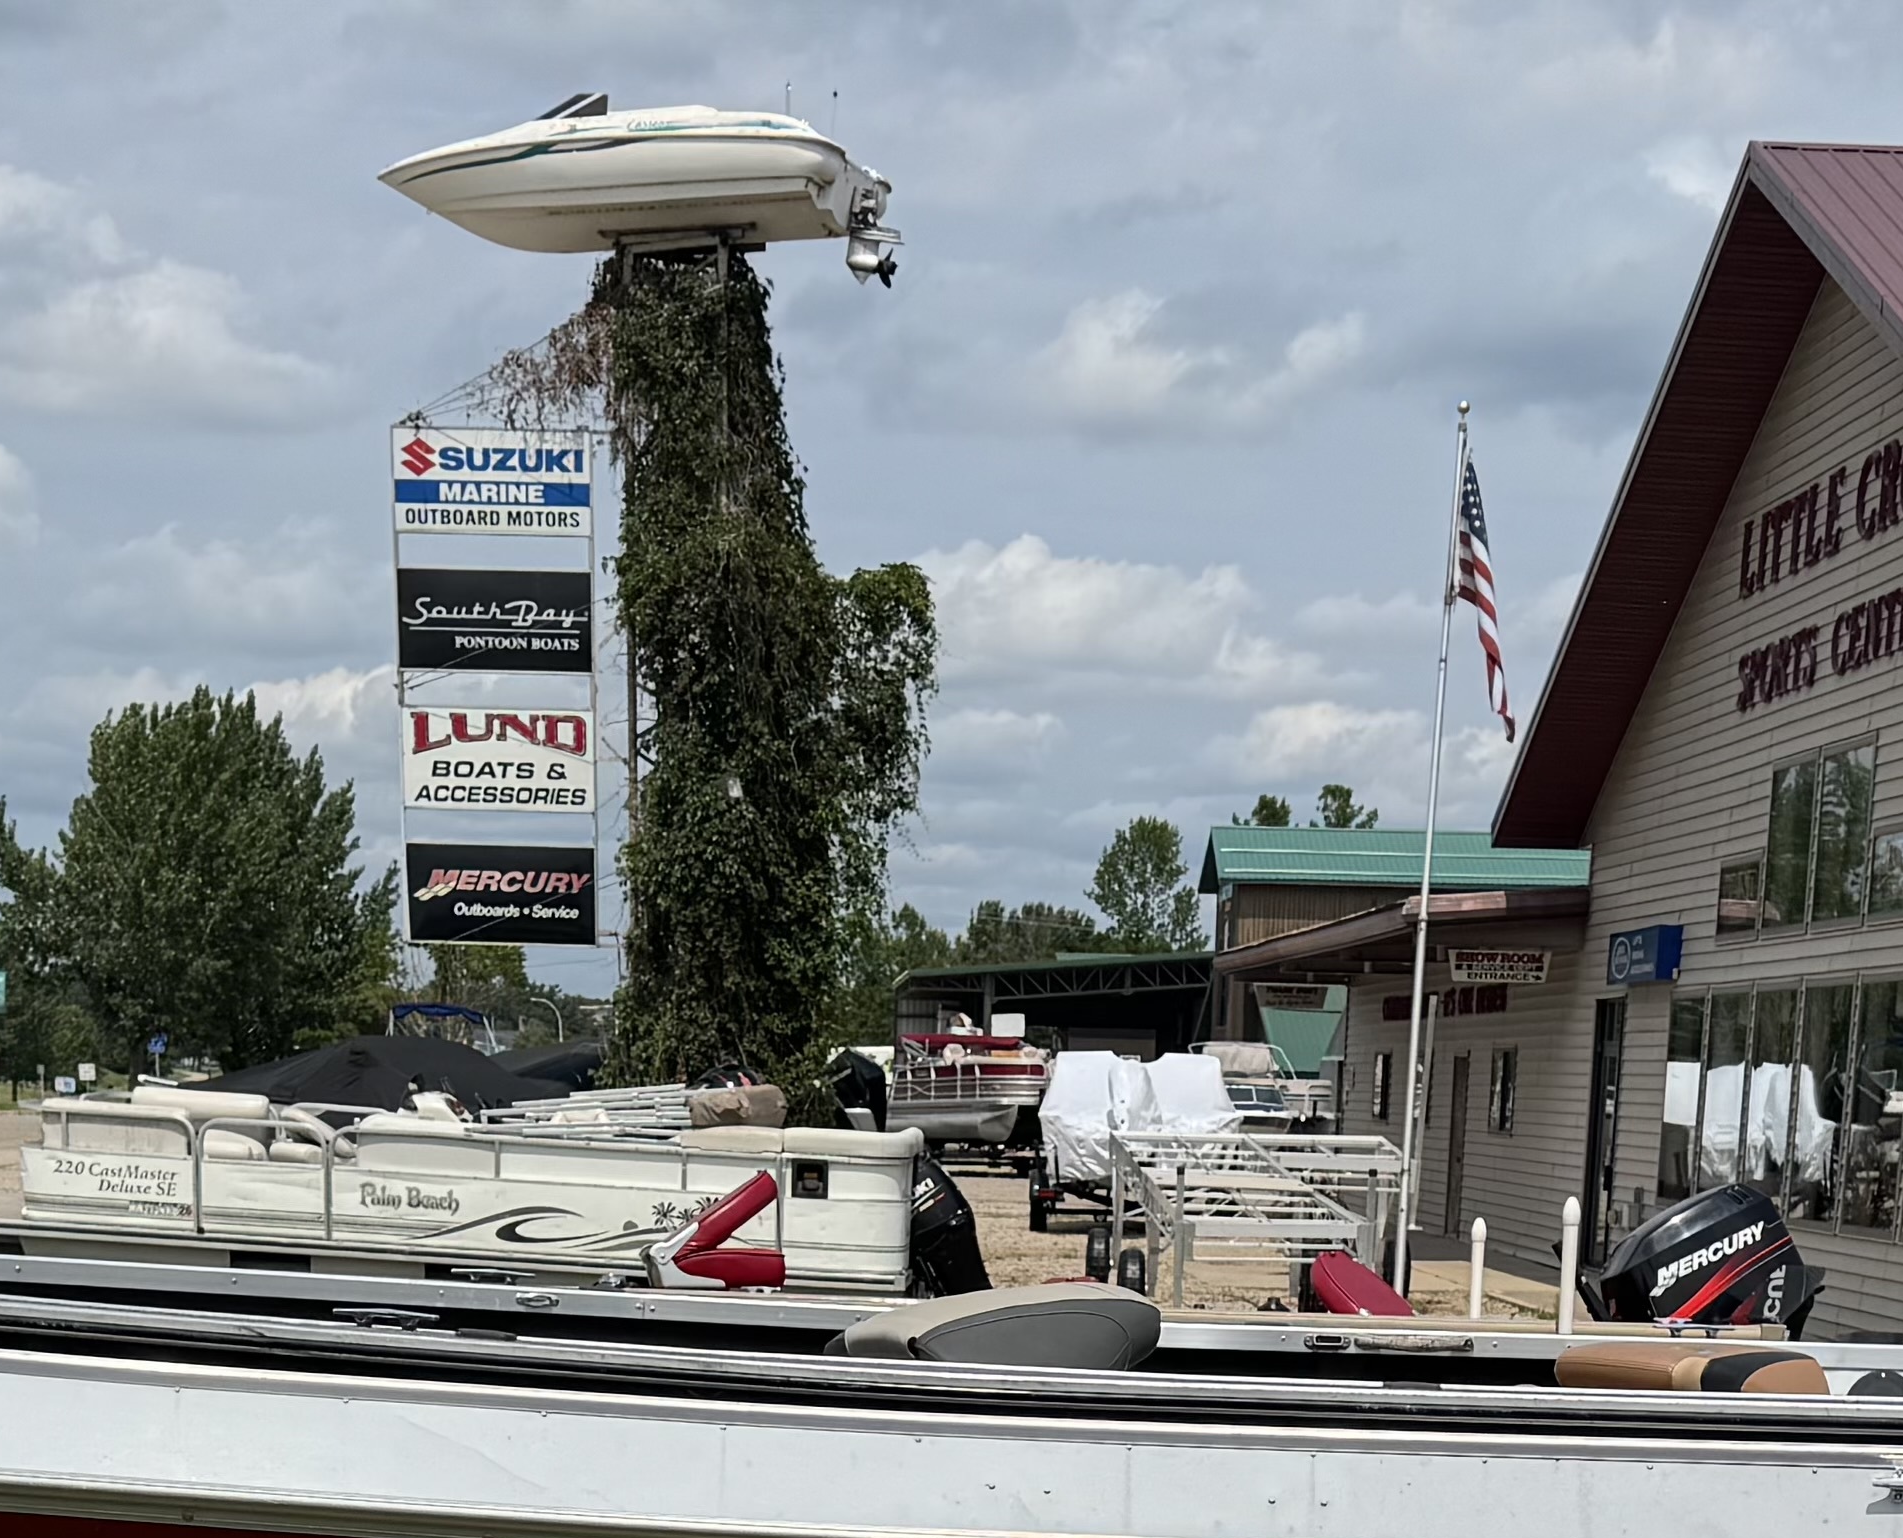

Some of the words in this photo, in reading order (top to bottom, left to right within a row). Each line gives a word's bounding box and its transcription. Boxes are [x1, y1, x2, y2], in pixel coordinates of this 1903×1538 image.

[438, 446, 584, 474] SUZUKI
[438, 482, 545, 504] MARINE
[405, 507, 500, 526] OUTBOARD
[507, 510, 580, 528] MOTORS
[1738, 465, 1847, 600] LITTLE
[402, 597, 501, 625] South
[504, 600, 578, 627] Bay
[454, 635, 528, 650] PONTOON
[531, 638, 580, 651] BOATS
[1736, 623, 1821, 712] SPORTS
[410, 711, 587, 757] LUND
[431, 760, 535, 779] BOATS
[546, 763, 567, 780] &
[414, 784, 587, 806] ACCESSORIES
[424, 868, 591, 896] MERCURY
[453, 902, 520, 918] Outboards
[531, 904, 580, 919] Service
[1467, 972, 1530, 980] ENTRANCE
[53, 1159, 85, 1175] 220
[88, 1162, 179, 1182] CastMaster
[98, 1179, 151, 1194] Deluxe
[155, 1182, 177, 1197] SE
[359, 1182, 402, 1210] Palm
[405, 1186, 460, 1216] Beach
[1654, 1220, 1765, 1293] MERCURY
